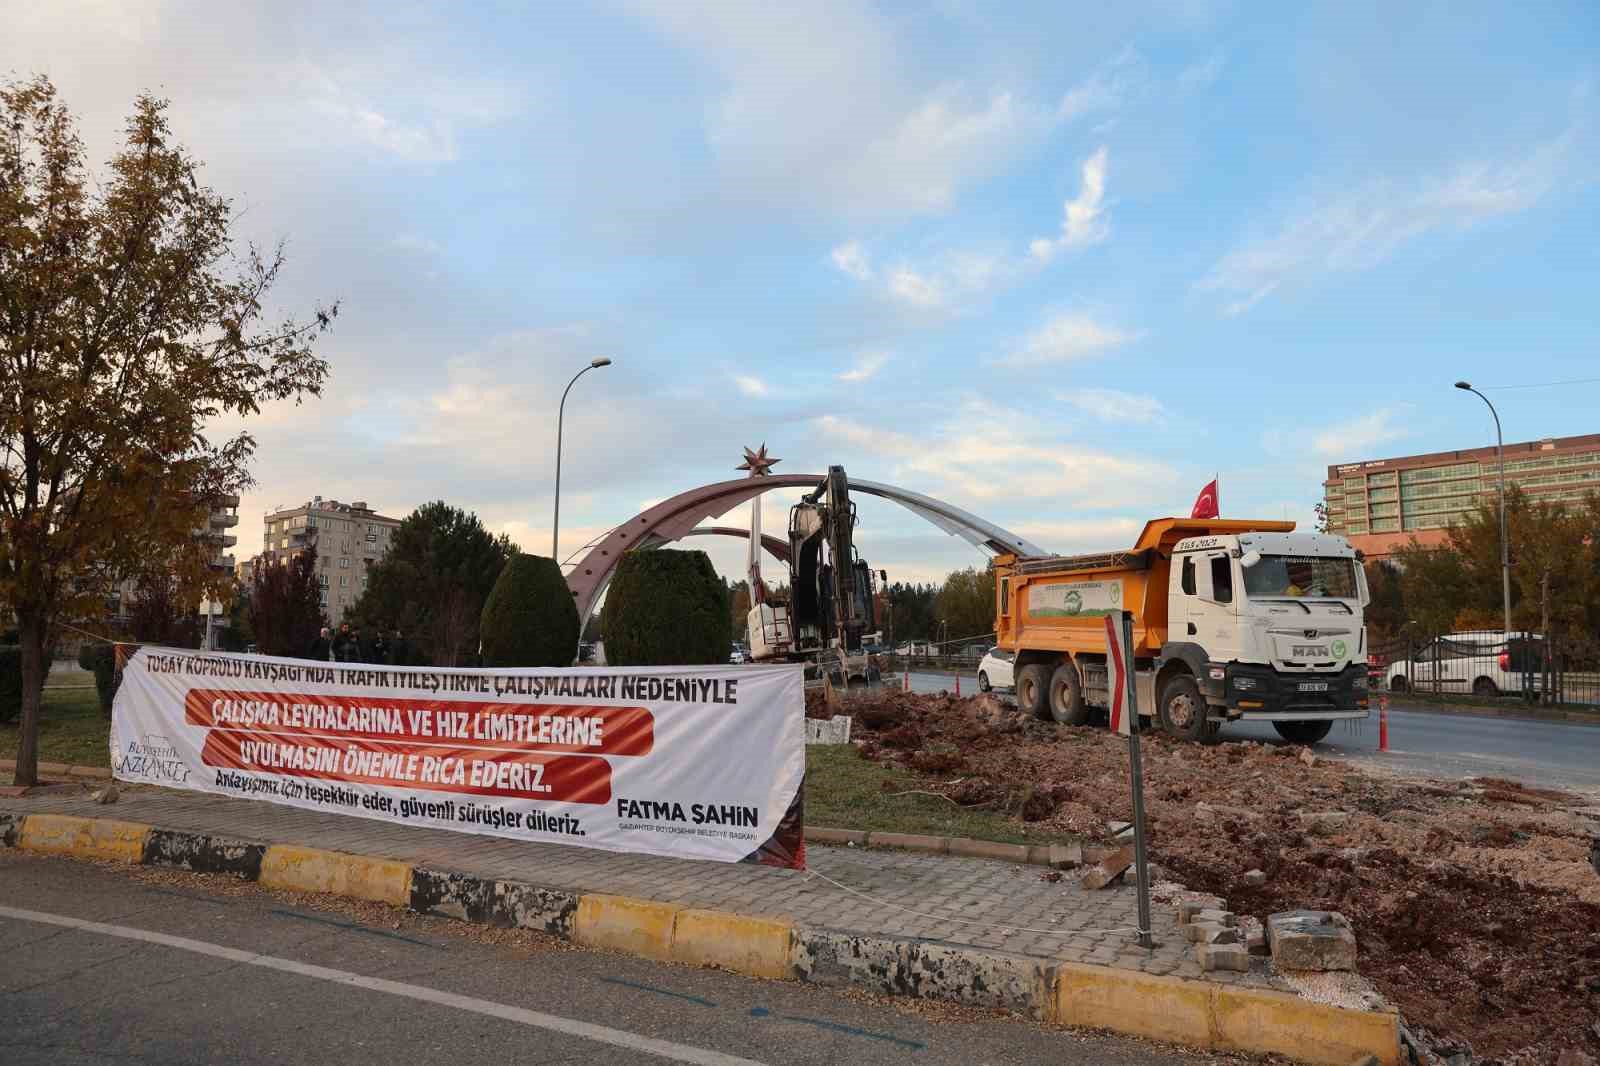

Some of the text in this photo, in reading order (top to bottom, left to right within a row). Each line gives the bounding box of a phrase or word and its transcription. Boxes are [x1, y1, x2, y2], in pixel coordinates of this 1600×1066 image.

[1292, 646, 1329, 657] MAN
[147, 655, 183, 674] TUGAY
[494, 675, 615, 699] ÇALIŞMALARI
[621, 676, 738, 705] NEDENİYLE
[212, 698, 603, 746] ÇALIŞMA LEVHALARINA VE HIZ LİMİTLERİNE
[240, 740, 552, 792] UYULMASINI ÖNEMLE RİCA EDERİZ.
[215, 769, 586, 836] Anlayışınız için teşekkür eder, güvenli sürüşler dileriz.
[617, 798, 758, 828] FATMA ŞAHİN
